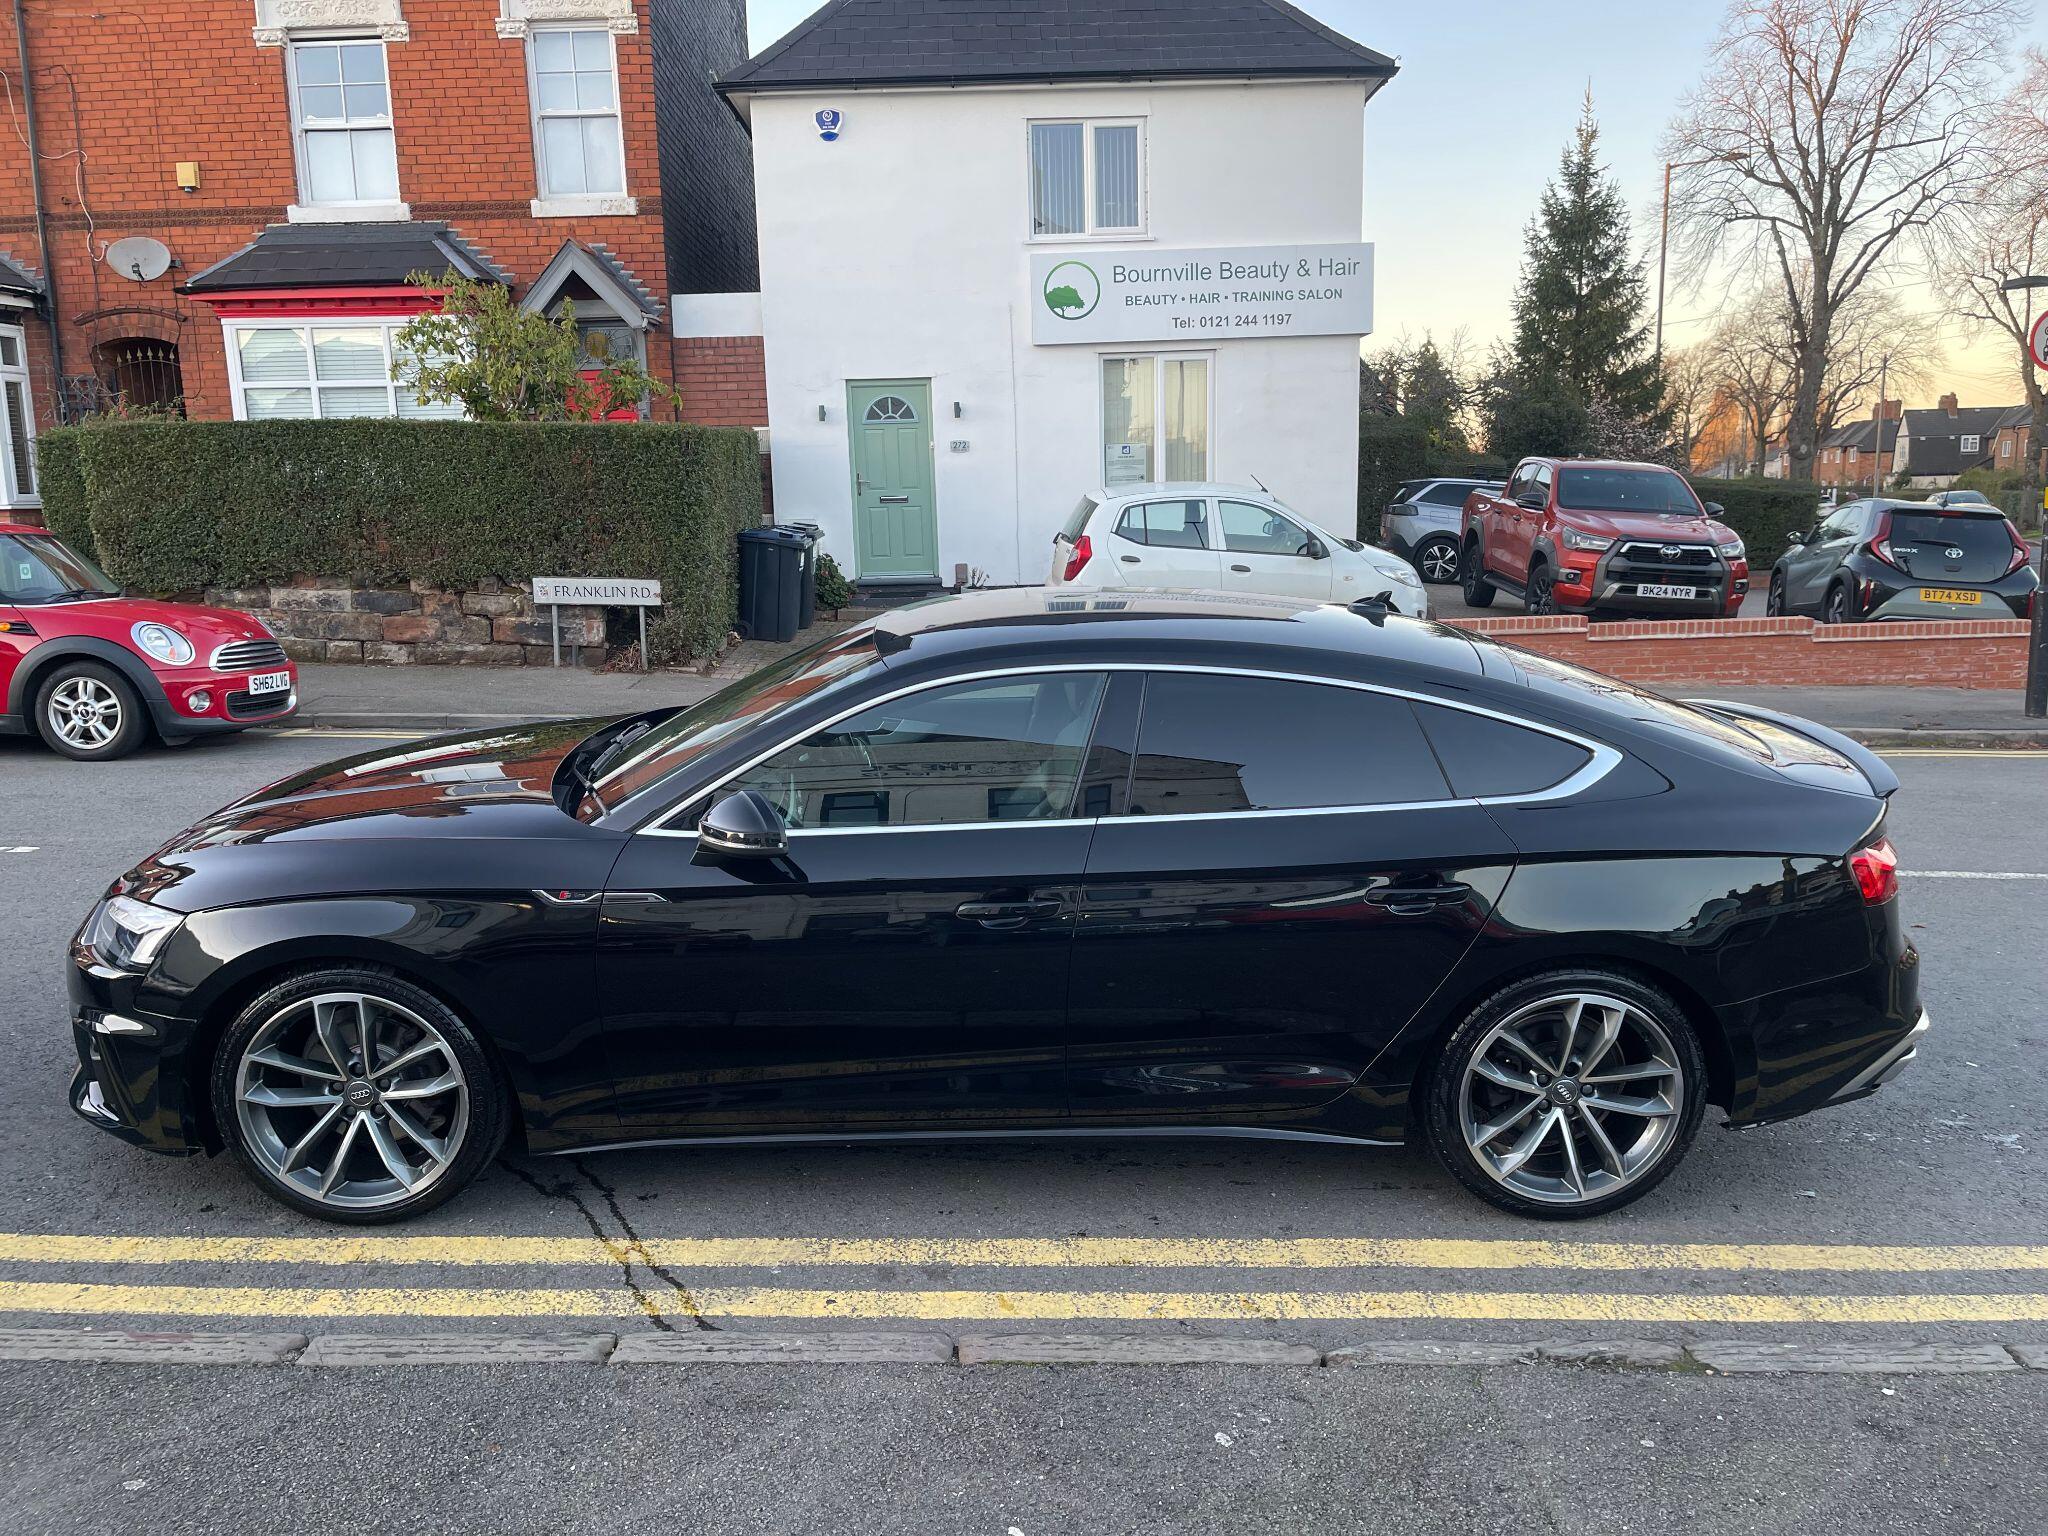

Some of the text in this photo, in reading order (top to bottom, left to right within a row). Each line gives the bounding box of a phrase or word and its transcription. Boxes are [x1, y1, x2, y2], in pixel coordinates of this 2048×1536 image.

[1113, 257, 1360, 283] Bournville Beauty & Hair
[1125, 288, 1343, 306] BEAUTY HAIR TRAINING SALON
[1172, 313, 1292, 329] Tel: 0121 244 1197
[952, 441, 967, 449] 272
[554, 585, 626, 598] FRANKLIN
[1642, 585, 1692, 598] BK24 NYR
[1924, 589, 1977, 602] BT74 XSD
[253, 673, 288, 692] SH62 LVG
